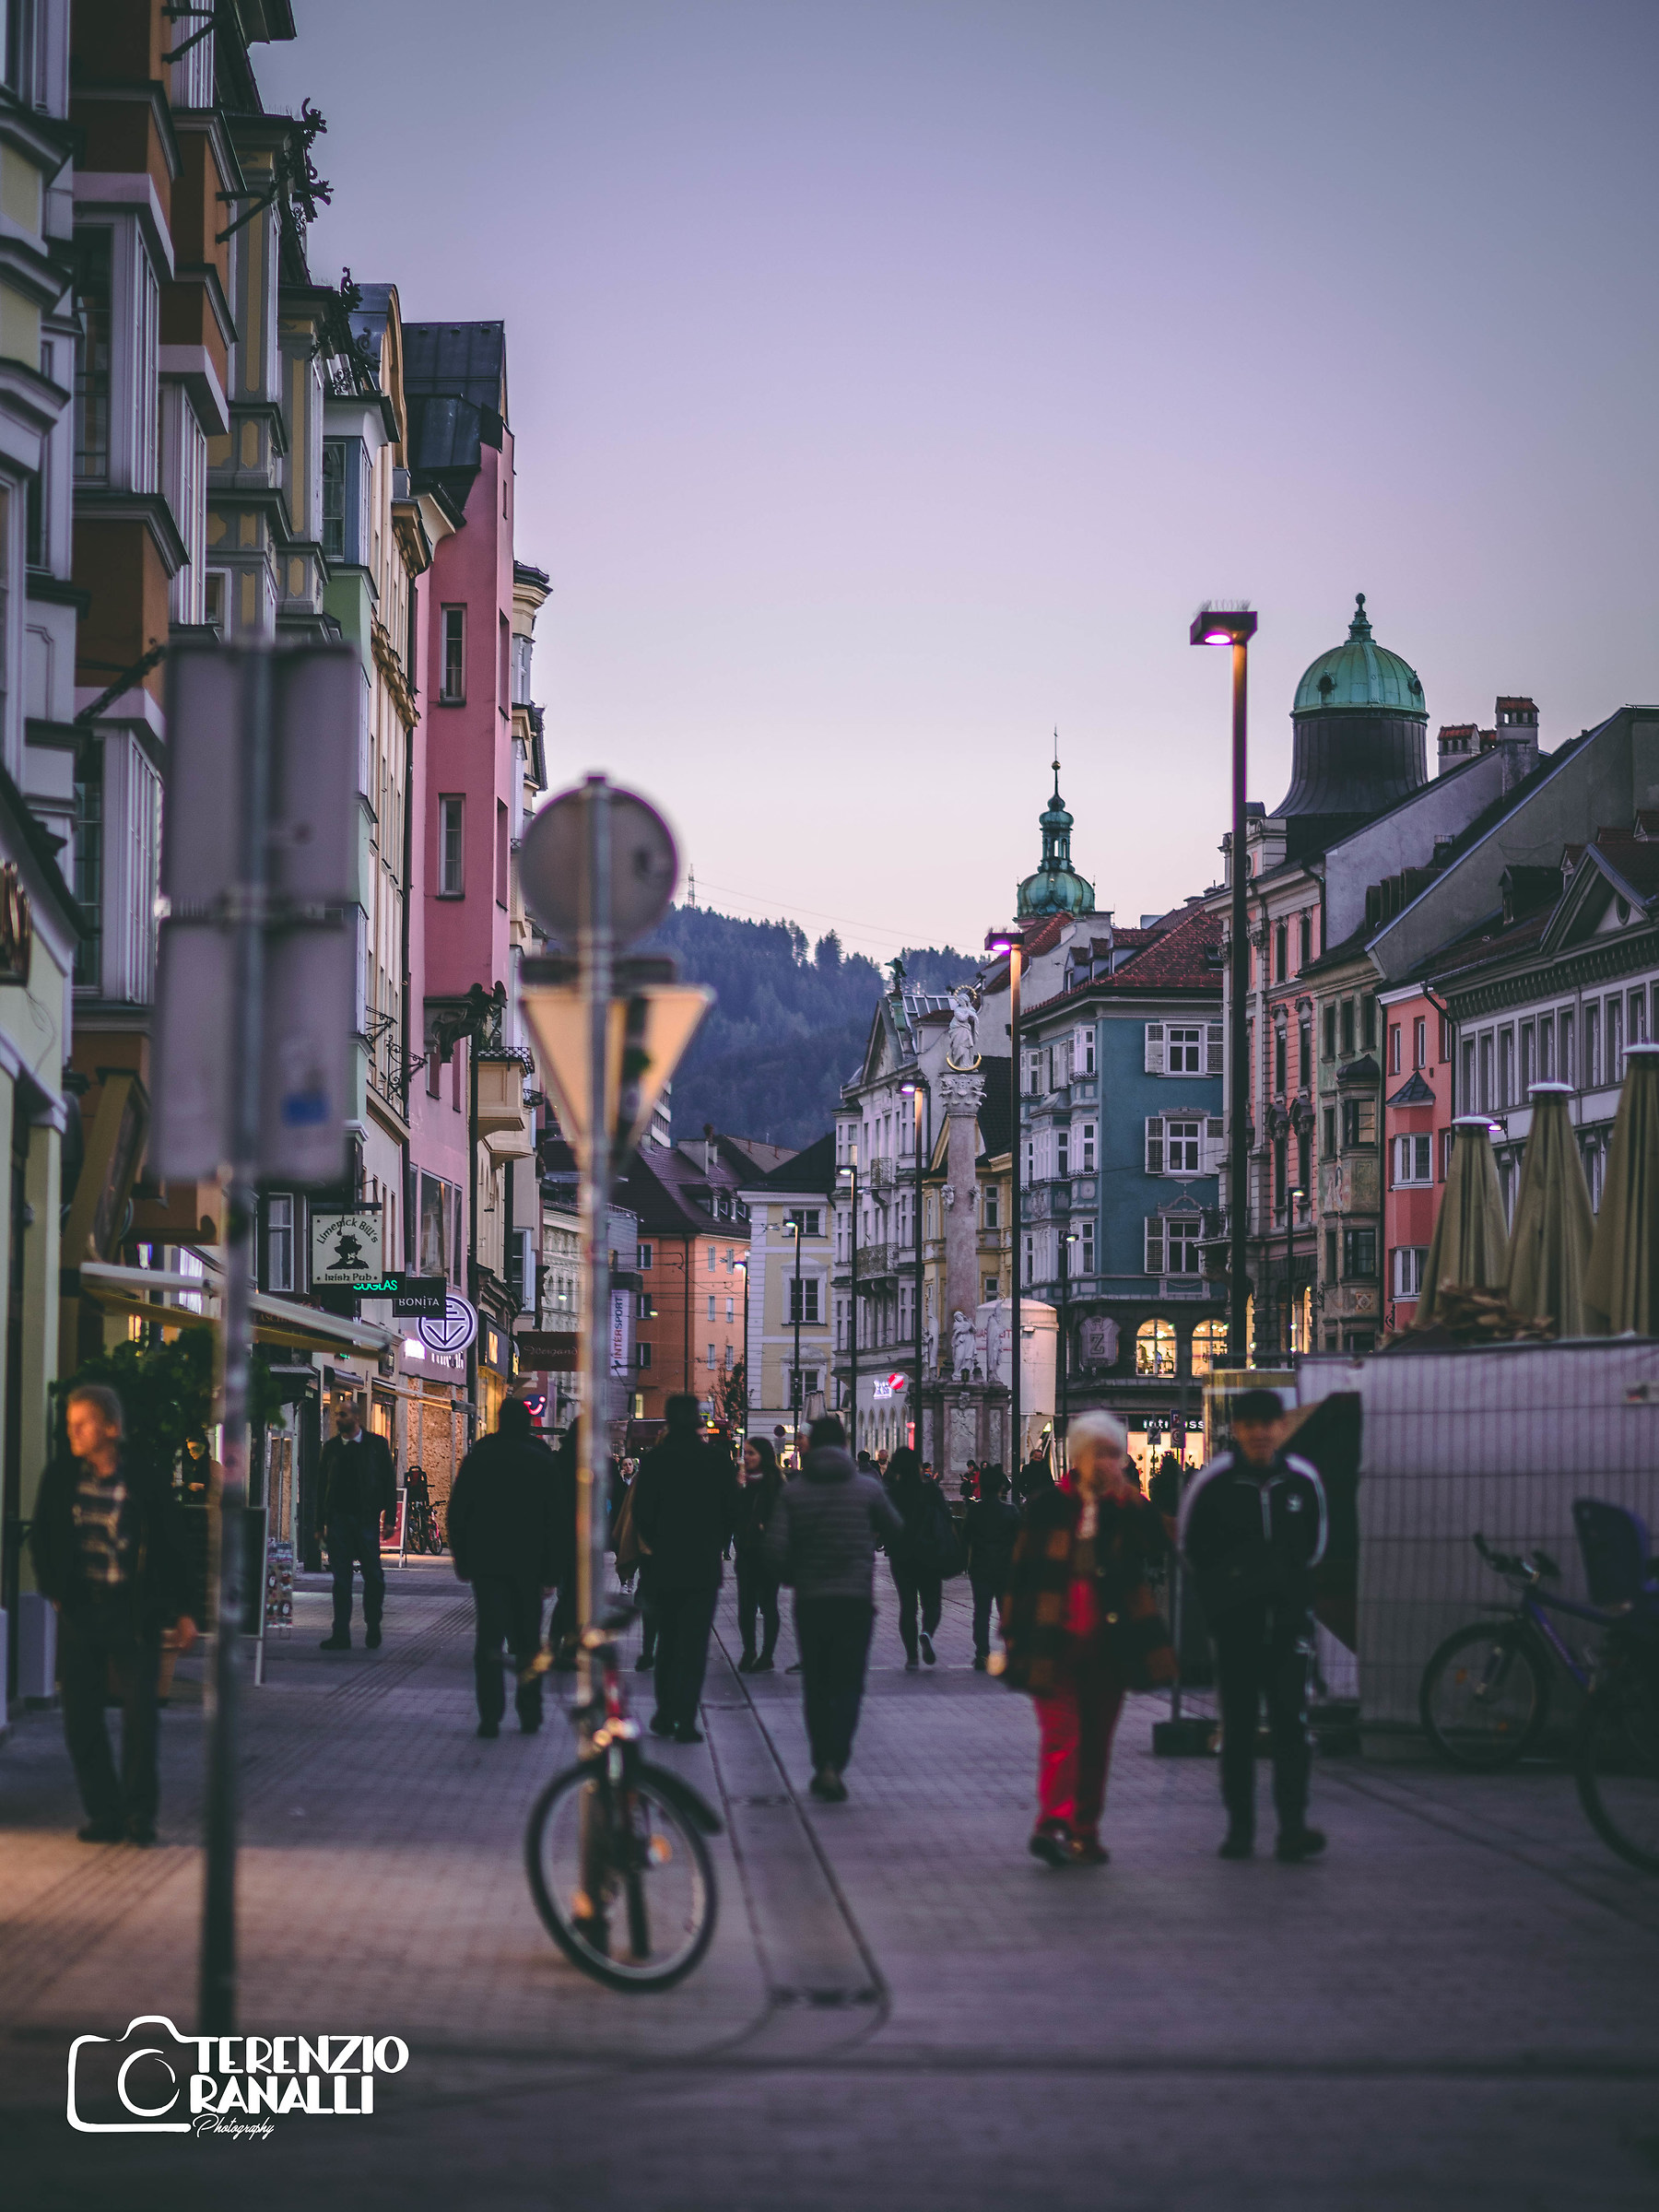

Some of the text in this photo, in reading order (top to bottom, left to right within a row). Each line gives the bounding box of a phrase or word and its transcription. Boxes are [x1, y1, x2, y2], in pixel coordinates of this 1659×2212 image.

[316, 1217, 379, 1244] Limerick Bill's
[324, 1273, 372, 1282] Irish Pub
[614, 1297, 624, 1359] INTERSPORT
